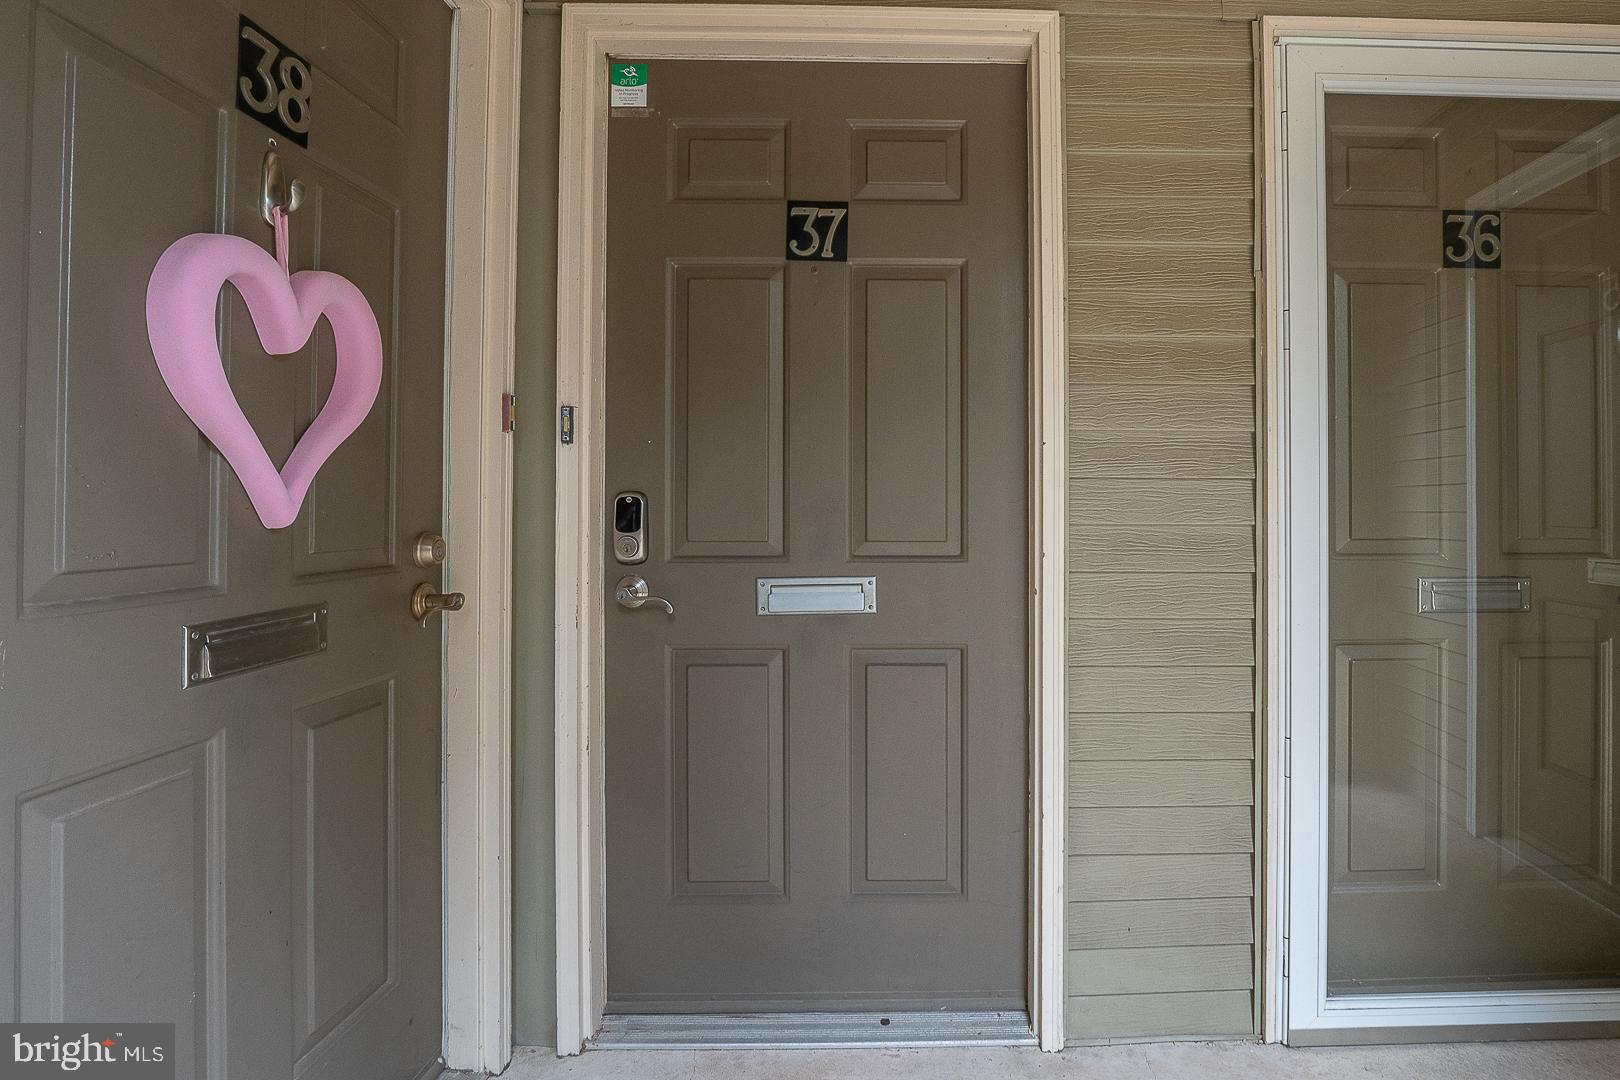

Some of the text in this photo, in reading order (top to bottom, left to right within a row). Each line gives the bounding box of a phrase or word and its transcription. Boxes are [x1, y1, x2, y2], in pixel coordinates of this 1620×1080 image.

[240, 26, 312, 133] 38
[620, 76, 637, 86] arlo
[789, 207, 847, 258] 37
[1446, 214, 1501, 262] 36
